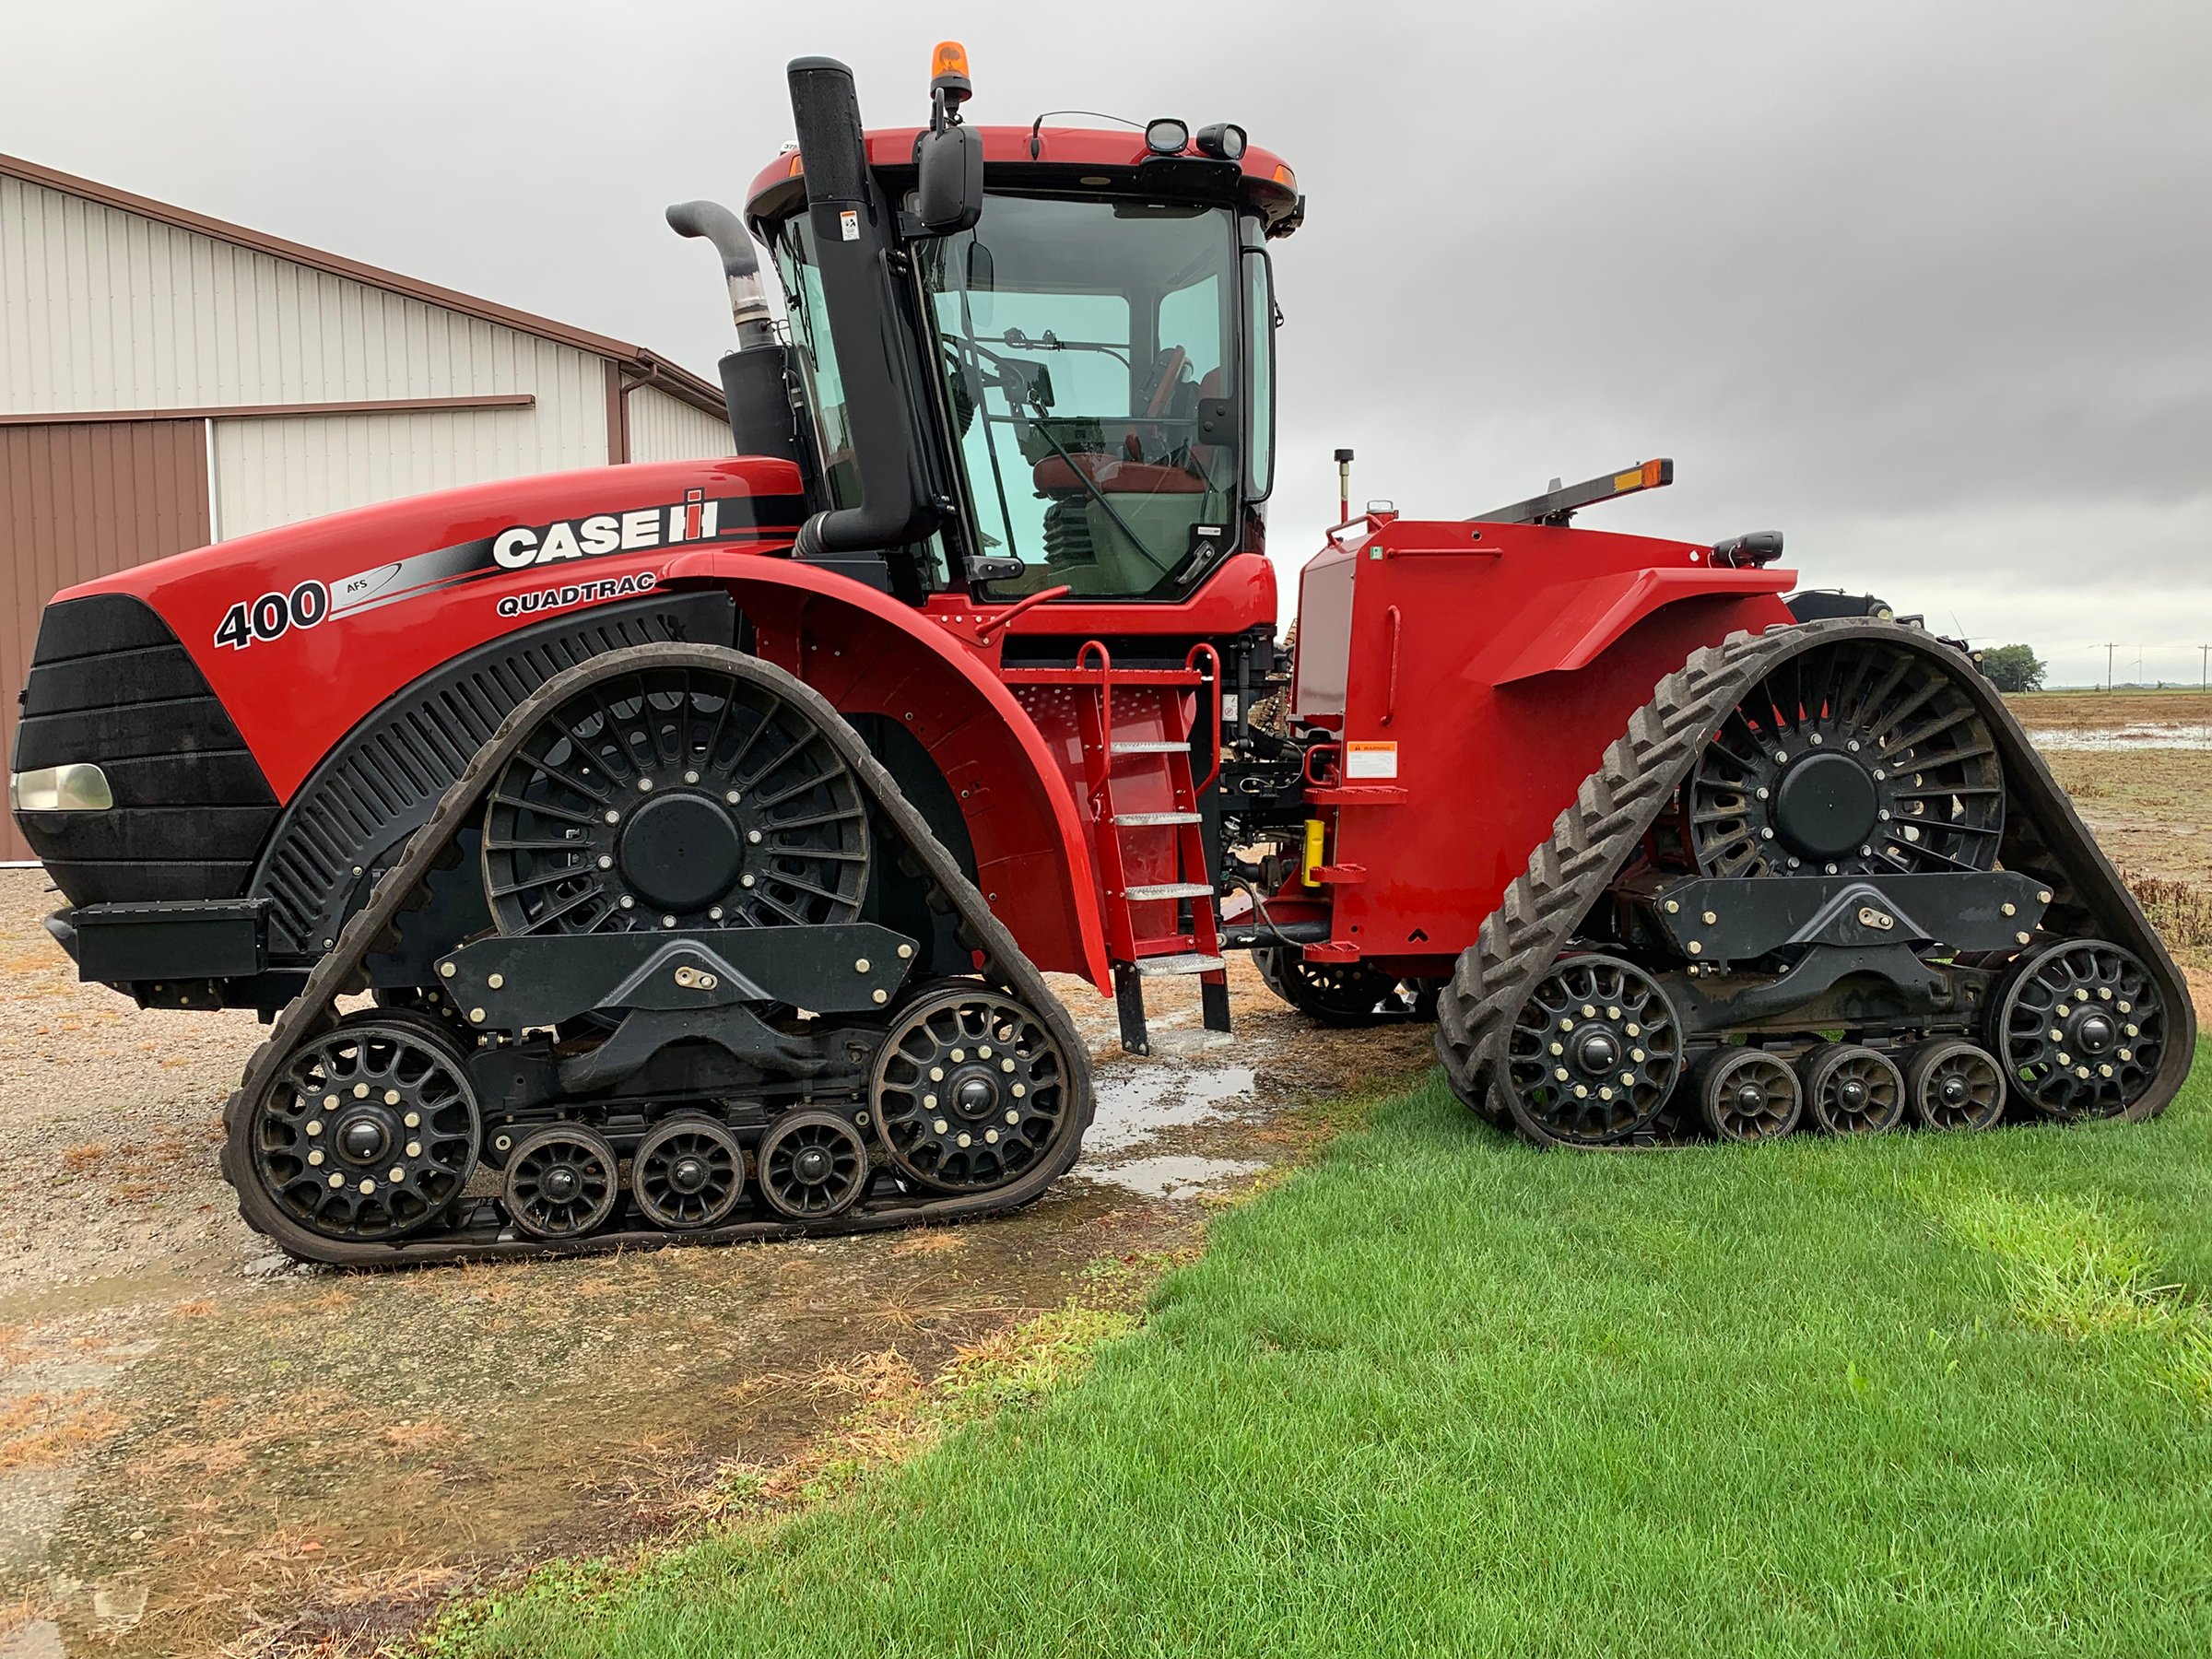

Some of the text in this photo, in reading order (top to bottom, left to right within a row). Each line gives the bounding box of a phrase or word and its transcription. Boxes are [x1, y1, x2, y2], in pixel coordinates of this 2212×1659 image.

[493, 509, 660, 569] CASE
[347, 579, 368, 594] AFS
[497, 571, 657, 618] QUADTRAC
[214, 579, 329, 651] 400
